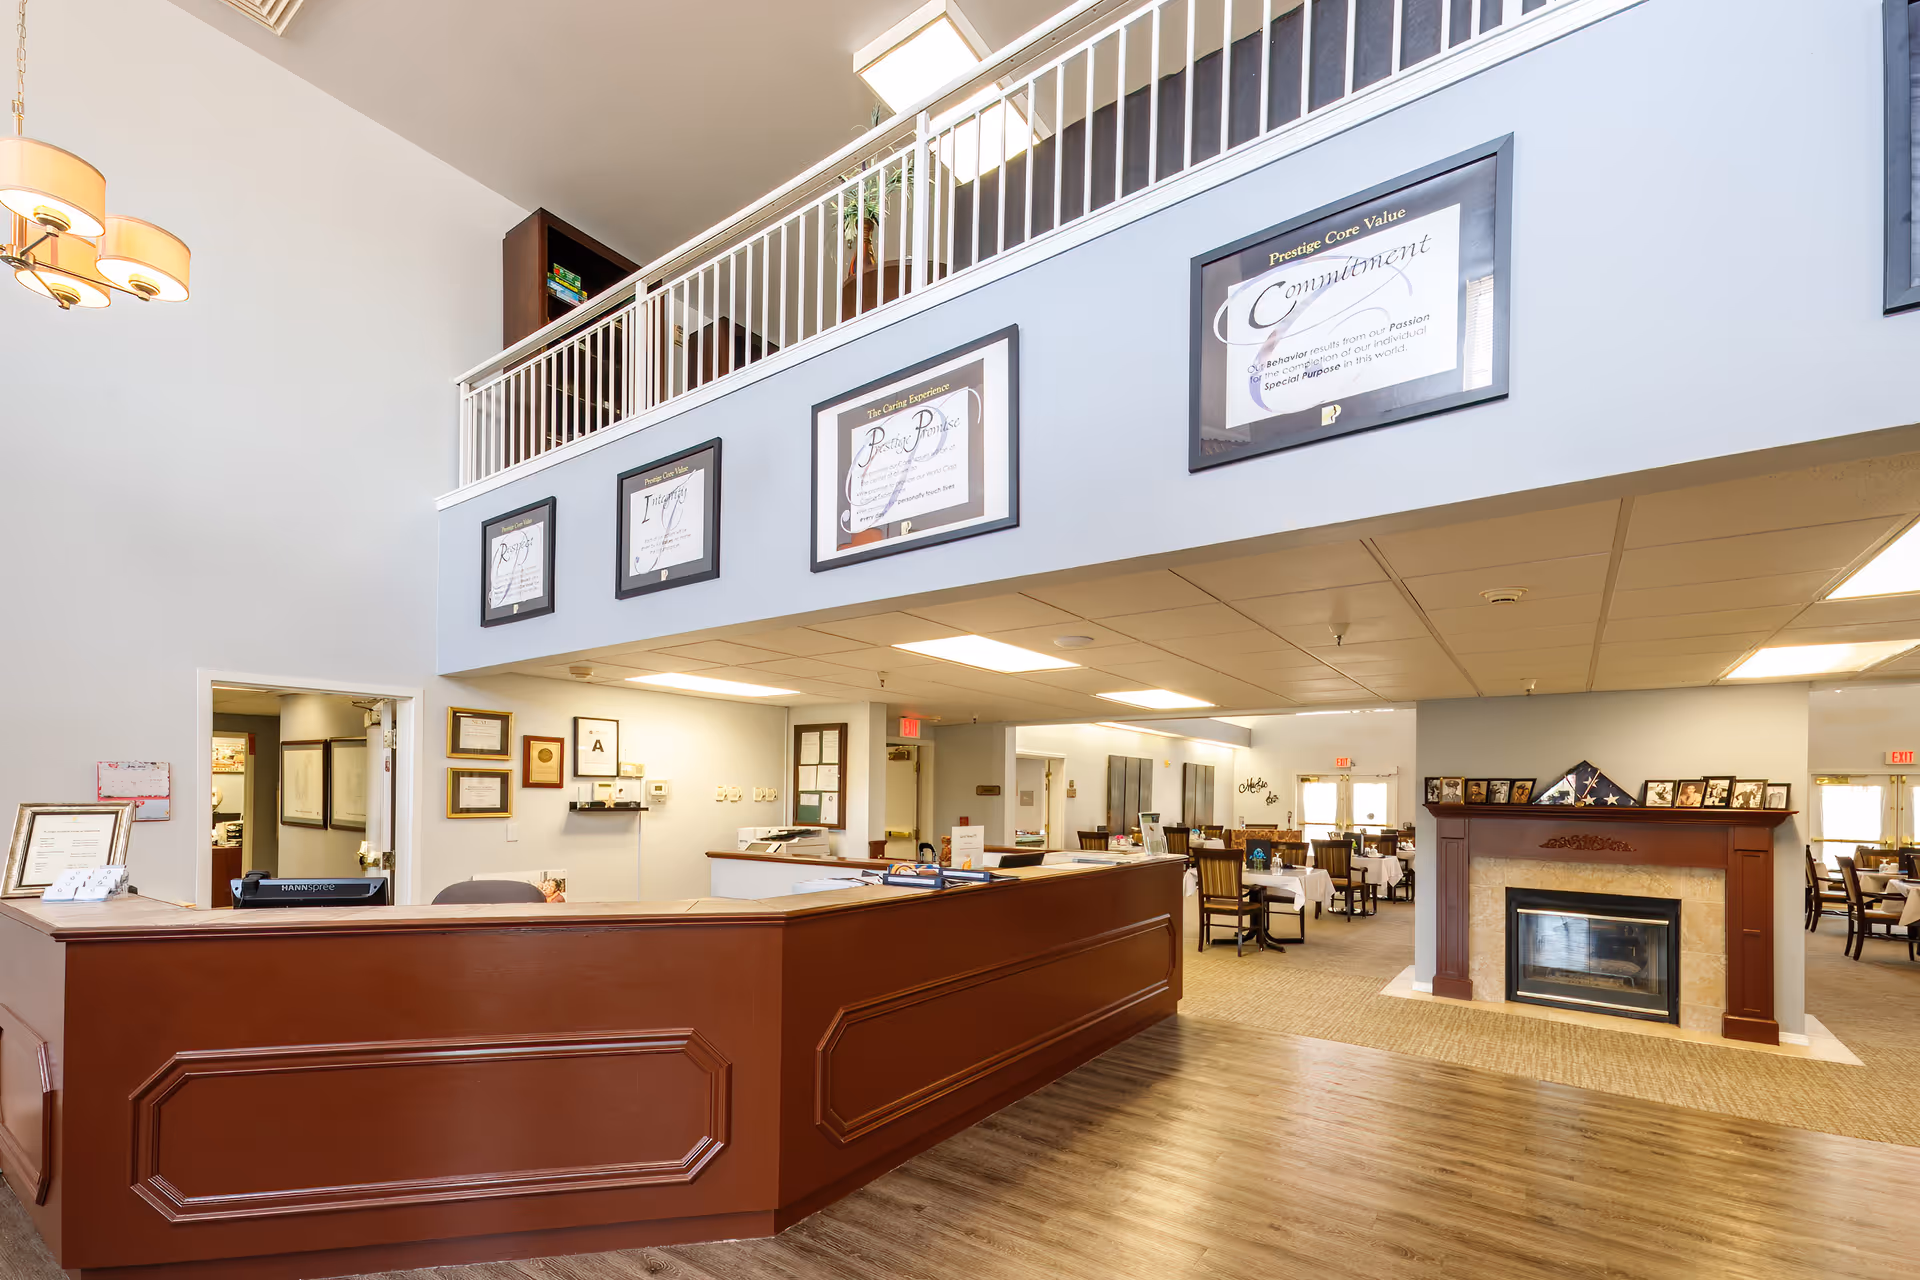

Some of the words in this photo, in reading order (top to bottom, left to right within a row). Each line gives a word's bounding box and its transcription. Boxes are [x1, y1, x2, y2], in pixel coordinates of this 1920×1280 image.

[1269, 239, 1322, 266] Prestige
[1325, 225, 1360, 244] Core
[1363, 208, 1406, 229] Value
[1248, 234, 1432, 329] Commitment
[1250, 375, 1262, 384] for
[1264, 369, 1278, 380] the
[1282, 353, 1339, 375] completion
[1340, 347, 1351, 358] of
[1353, 343, 1371, 354] our
[1373, 325, 1427, 348] individual
[1266, 350, 1308, 368] Behavior
[1309, 340, 1340, 355] results
[1342, 333, 1366, 346] from
[1368, 327, 1386, 339] our
[1389, 313, 1430, 332] Passion
[1264, 375, 1300, 391] Special
[1302, 363, 1341, 381] Purpose
[1343, 359, 1353, 368] in
[1356, 353, 1372, 365] this
[1374, 343, 1408, 359] world.
[867, 408, 881, 419] The
[882, 399, 907, 413] Caring
[909, 383, 950, 404] Experience
[903, 409, 960, 453] Promise
[641, 486, 688, 524] Integrity
[897, 491, 925, 505] personally
[925, 486, 941, 496] touch
[592, 739, 604, 752] A
[1892, 751, 1914, 764] EXIT
[281, 883, 336, 893] HANNspree
